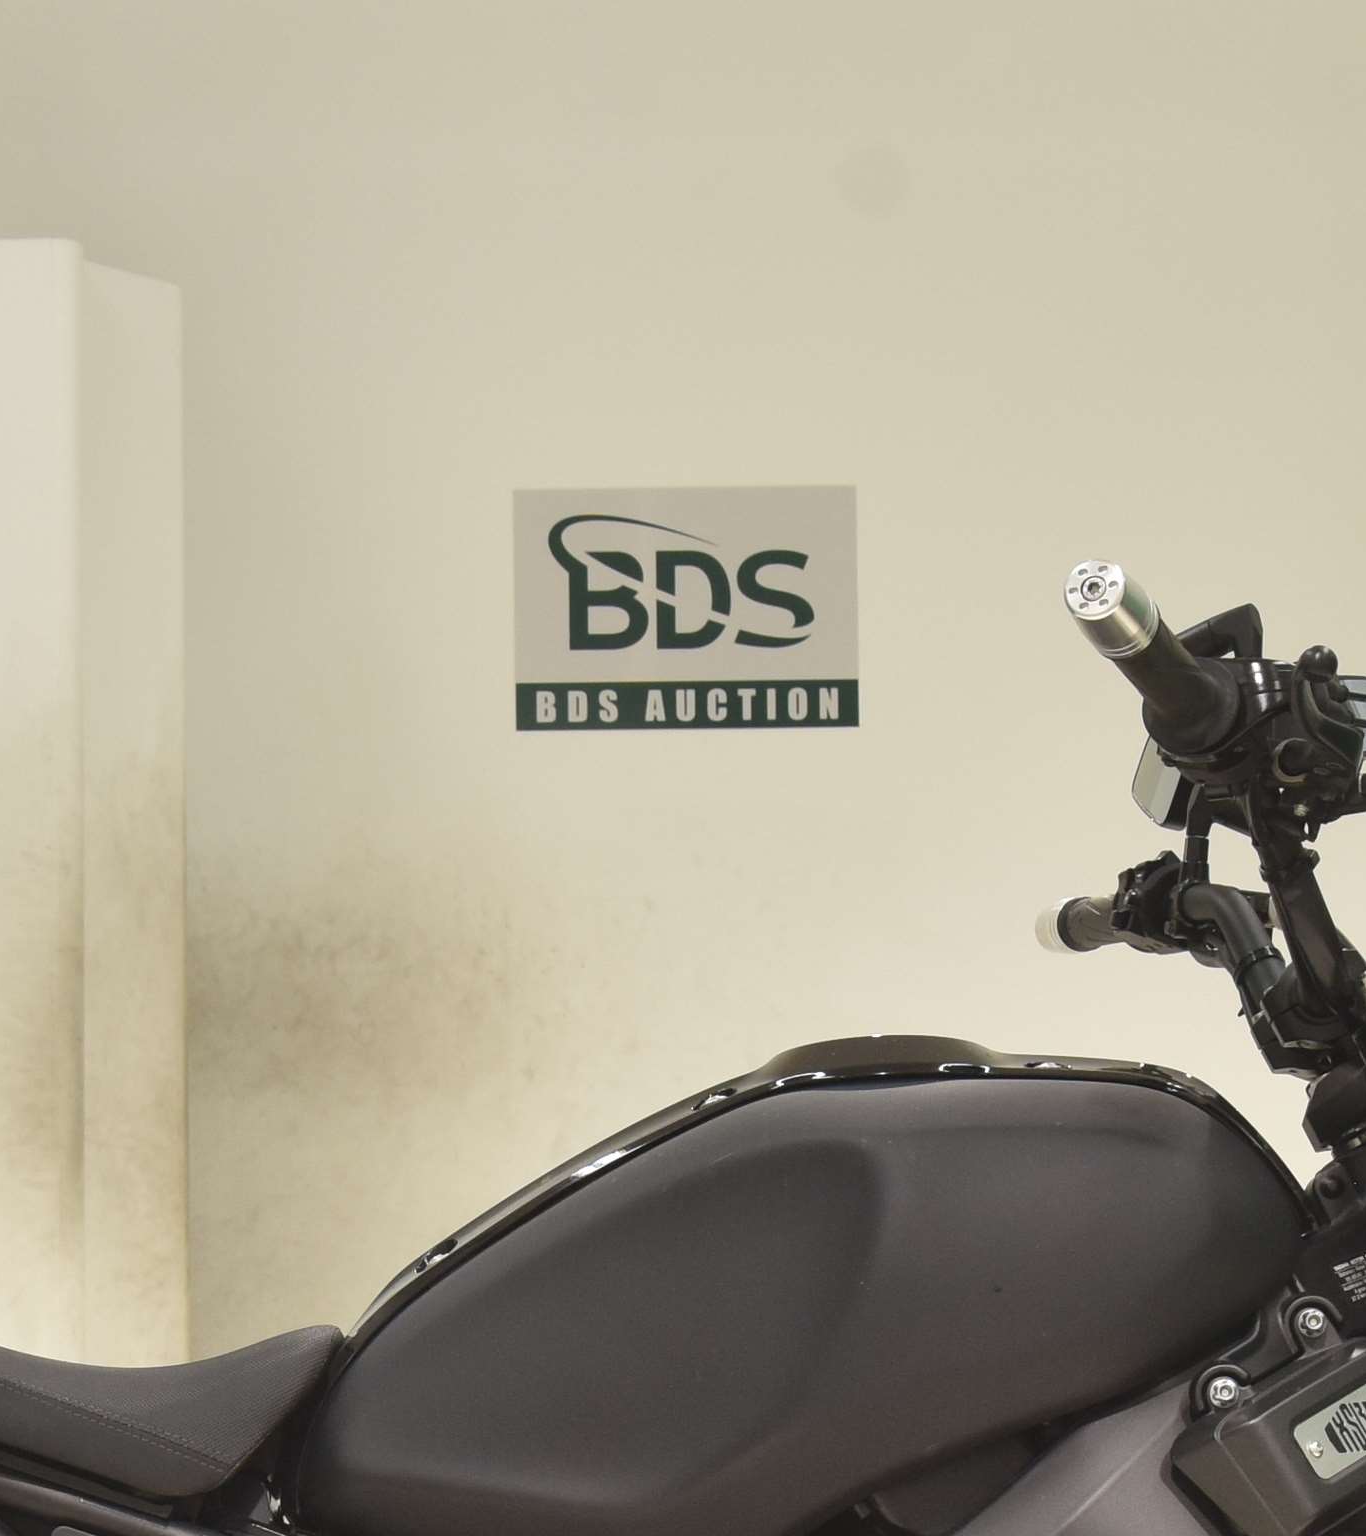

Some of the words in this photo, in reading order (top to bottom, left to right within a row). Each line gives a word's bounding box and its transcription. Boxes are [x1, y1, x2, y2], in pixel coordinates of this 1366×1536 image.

[548, 514, 815, 650] BDS
[536, 689, 619, 723] BDS
[645, 687, 840, 722] AUCTION
